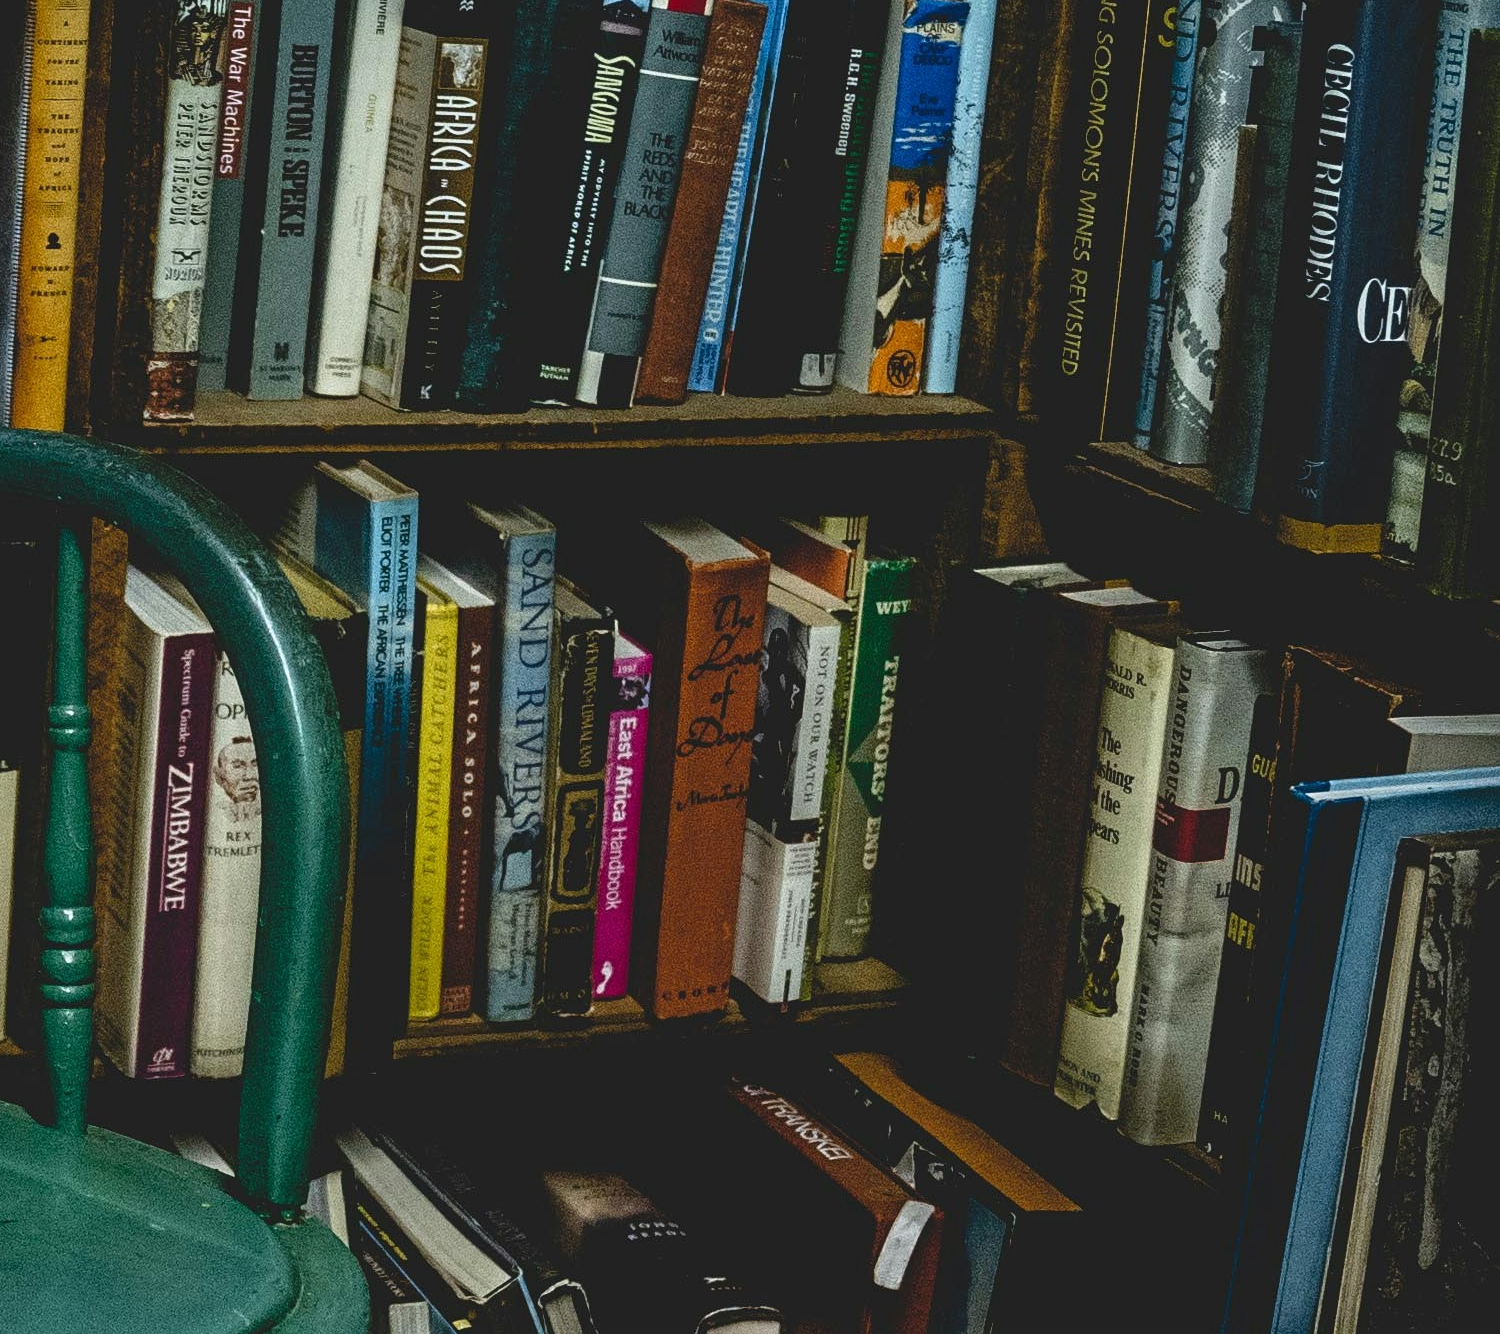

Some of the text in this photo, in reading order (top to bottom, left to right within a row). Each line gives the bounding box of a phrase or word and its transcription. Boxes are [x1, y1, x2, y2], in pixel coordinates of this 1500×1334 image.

[219, 5, 252, 176] The Machines
[1303, 42, 1357, 303] CECIL RHODES
[418, 94, 462, 278] AFRICA CHAOS
[506, 547, 553, 833] SAND RIVERS
[158, 762, 195, 913] ZIMBABWE
[603, 715, 639, 912] East Africa Handbook
[861, 815, 884, 872] END
